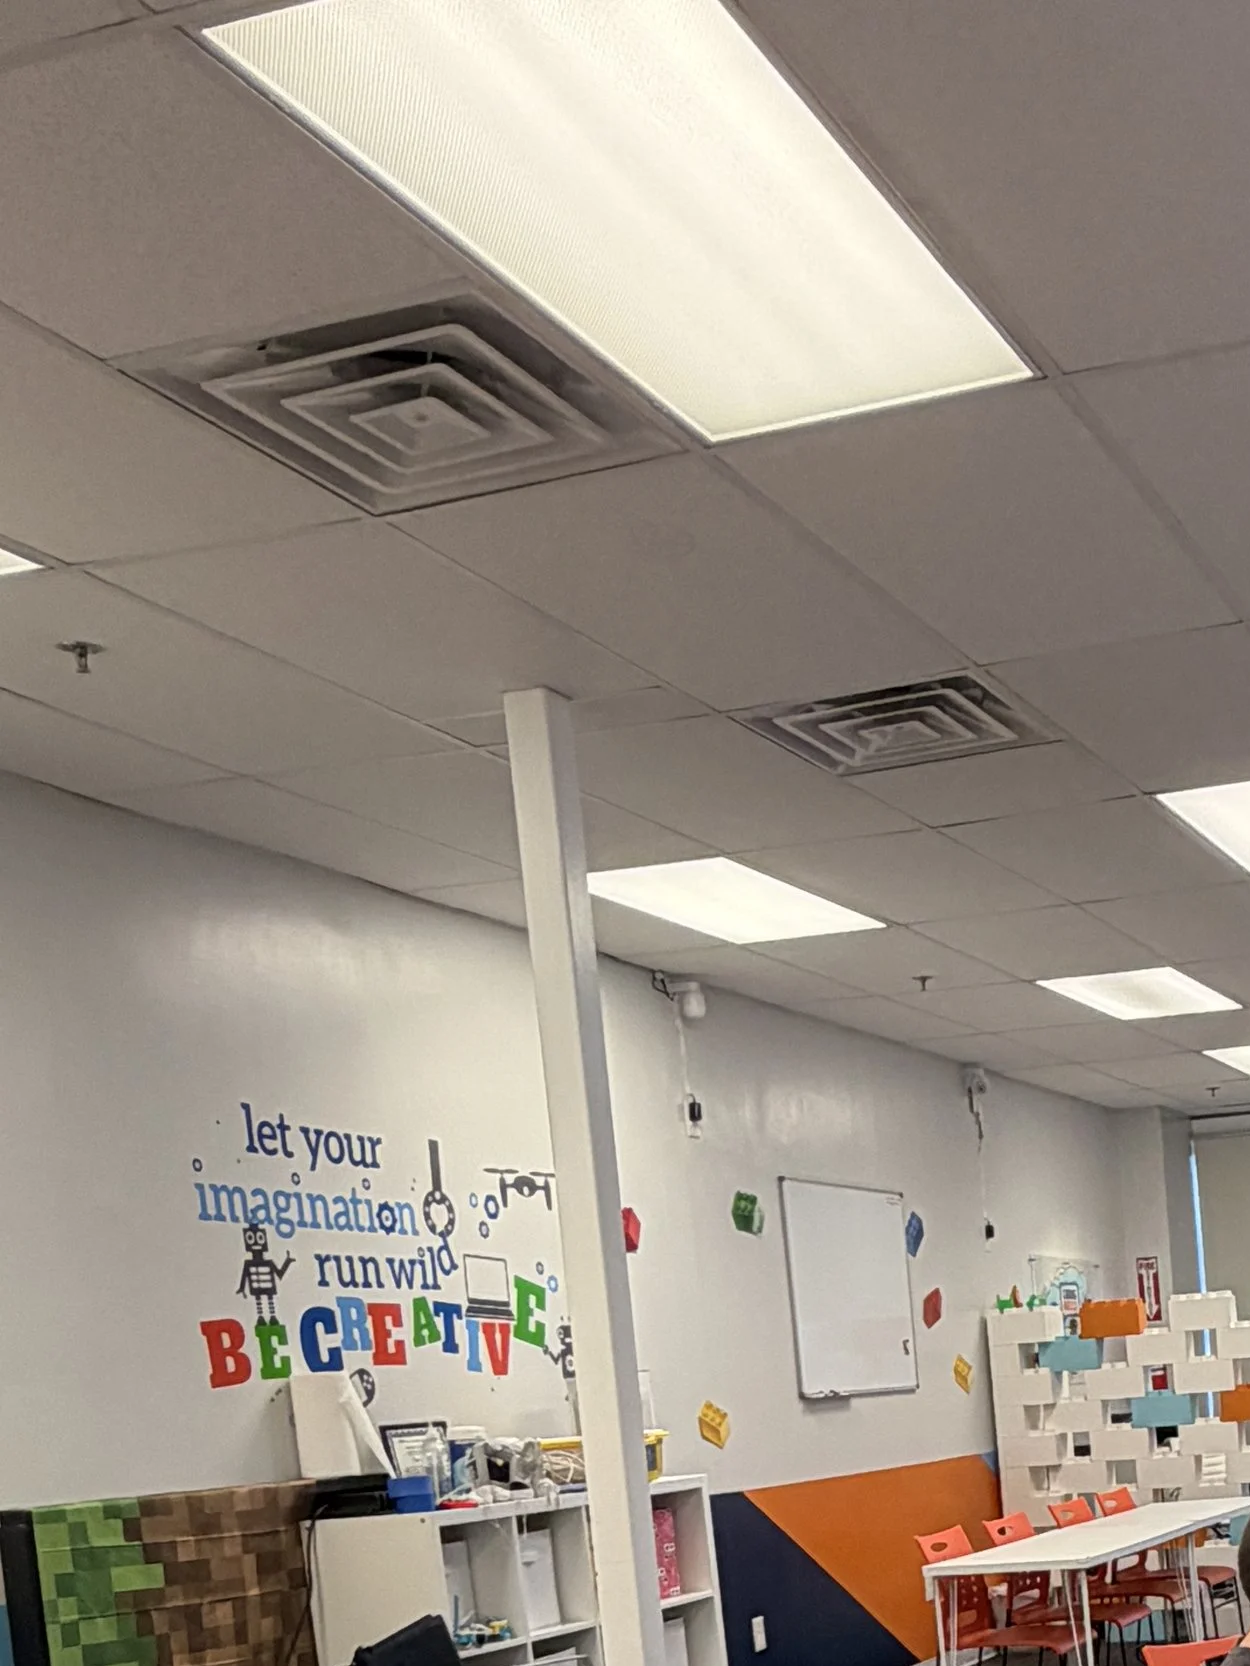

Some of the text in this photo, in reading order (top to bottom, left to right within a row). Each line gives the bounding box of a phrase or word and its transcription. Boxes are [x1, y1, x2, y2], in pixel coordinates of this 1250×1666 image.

[240, 1102, 382, 1171] let your
[193, 1169, 420, 1240] imagination
[313, 1233, 459, 1291] run wild
[200, 1274, 547, 1389] BE CREATIVE
